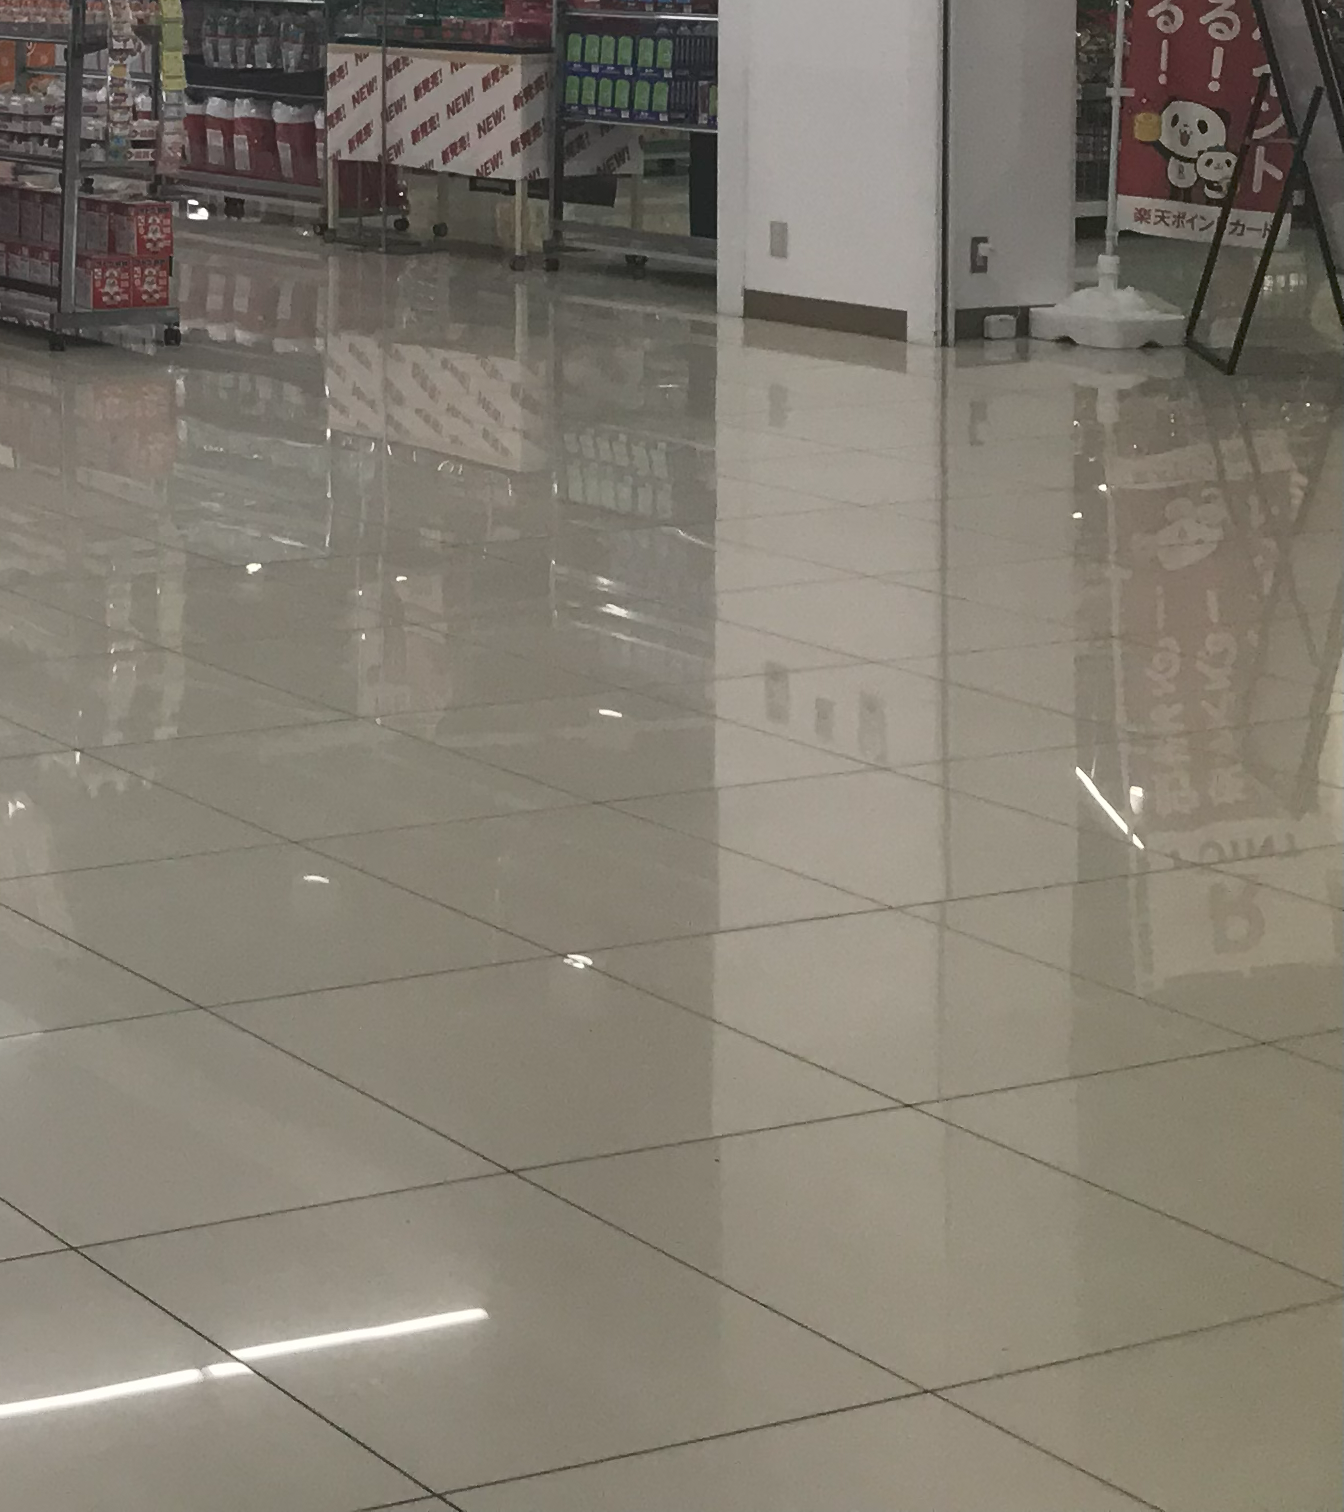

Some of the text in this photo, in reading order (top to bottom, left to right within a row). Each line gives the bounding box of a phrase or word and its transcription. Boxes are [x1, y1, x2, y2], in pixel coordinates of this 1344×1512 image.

[351, 75, 378, 110] NEW!
[446, 86, 475, 120] NEW!
[476, 104, 507, 139] NEW!
